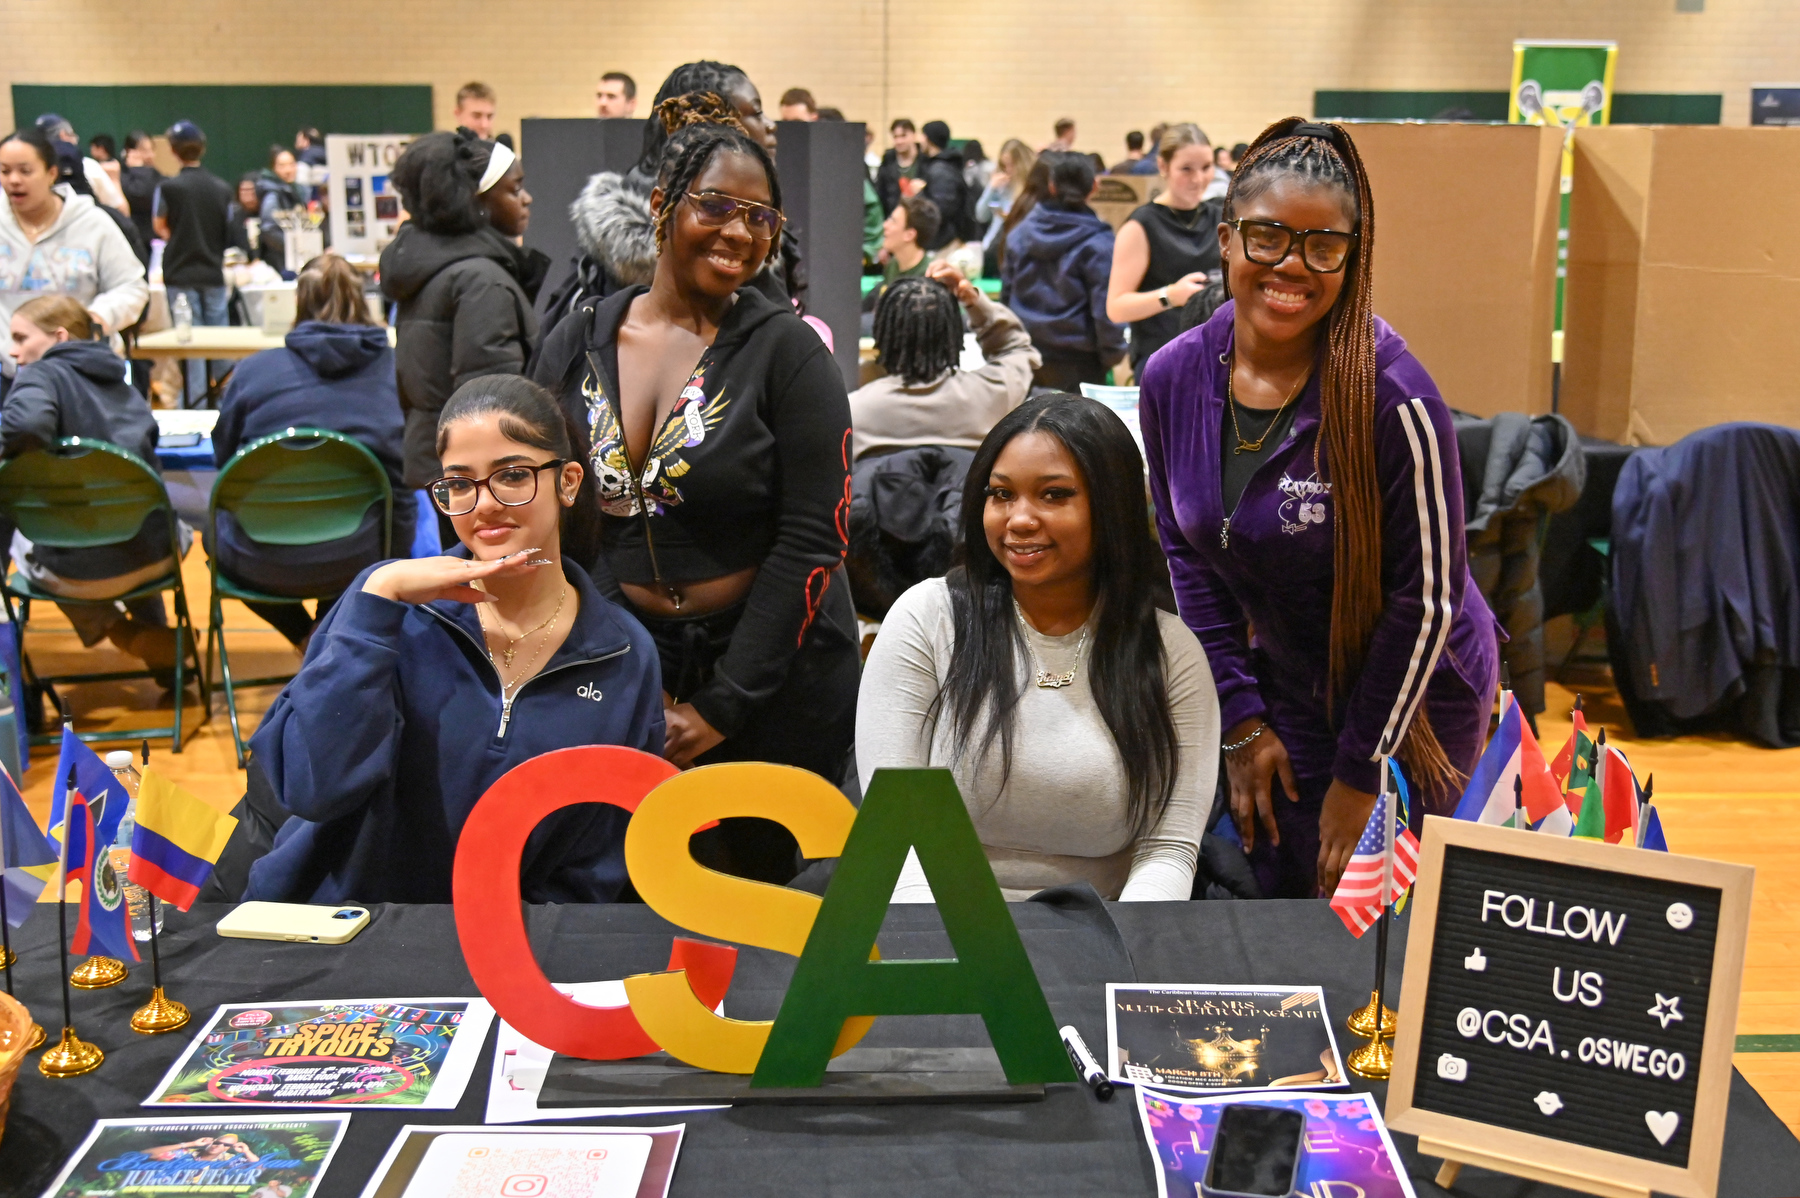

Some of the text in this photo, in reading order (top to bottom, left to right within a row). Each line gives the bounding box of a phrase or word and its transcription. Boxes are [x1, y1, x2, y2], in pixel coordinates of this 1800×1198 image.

[687, 409, 701, 441] YORK
[1298, 502, 1326, 523] 53
[577, 682, 603, 702] alo
[453, 744, 1079, 1088] CSA
[1481, 889, 1627, 946] FOLLOW
[1552, 966, 1603, 1007] US
[293, 1022, 382, 1041] SPICE
[263, 1037, 394, 1057] TRYOUTS
[239, 1068, 279, 1077] MONDAY
[277, 1067, 321, 1075] FEBRUARY
[284, 1073, 342, 1082] DANCE ROOM
[227, 1083, 281, 1092] WEDNESDAY
[306, 1088, 335, 1096] ROOM
[197, 1169, 263, 1185] FEVER
